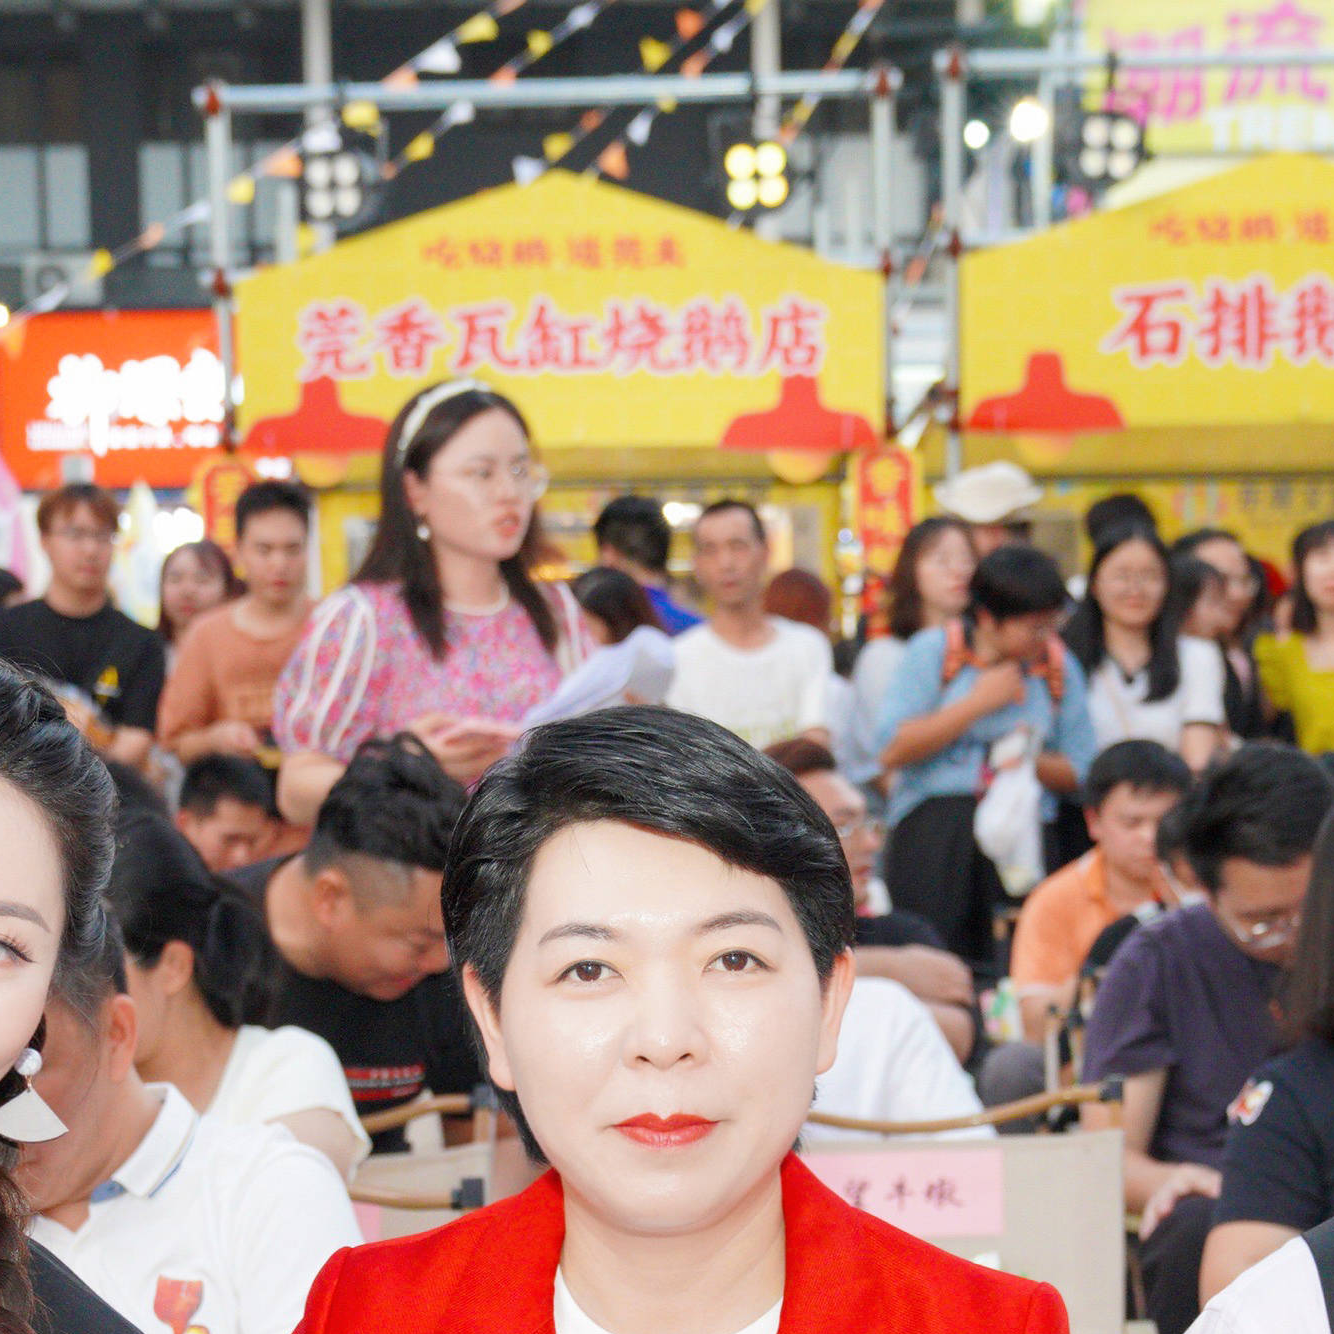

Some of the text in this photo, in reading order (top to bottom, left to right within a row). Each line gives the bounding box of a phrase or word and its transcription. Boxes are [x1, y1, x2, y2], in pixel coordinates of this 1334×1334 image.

[298, 300, 825, 376] 莞香瓦缸烧鹅店
